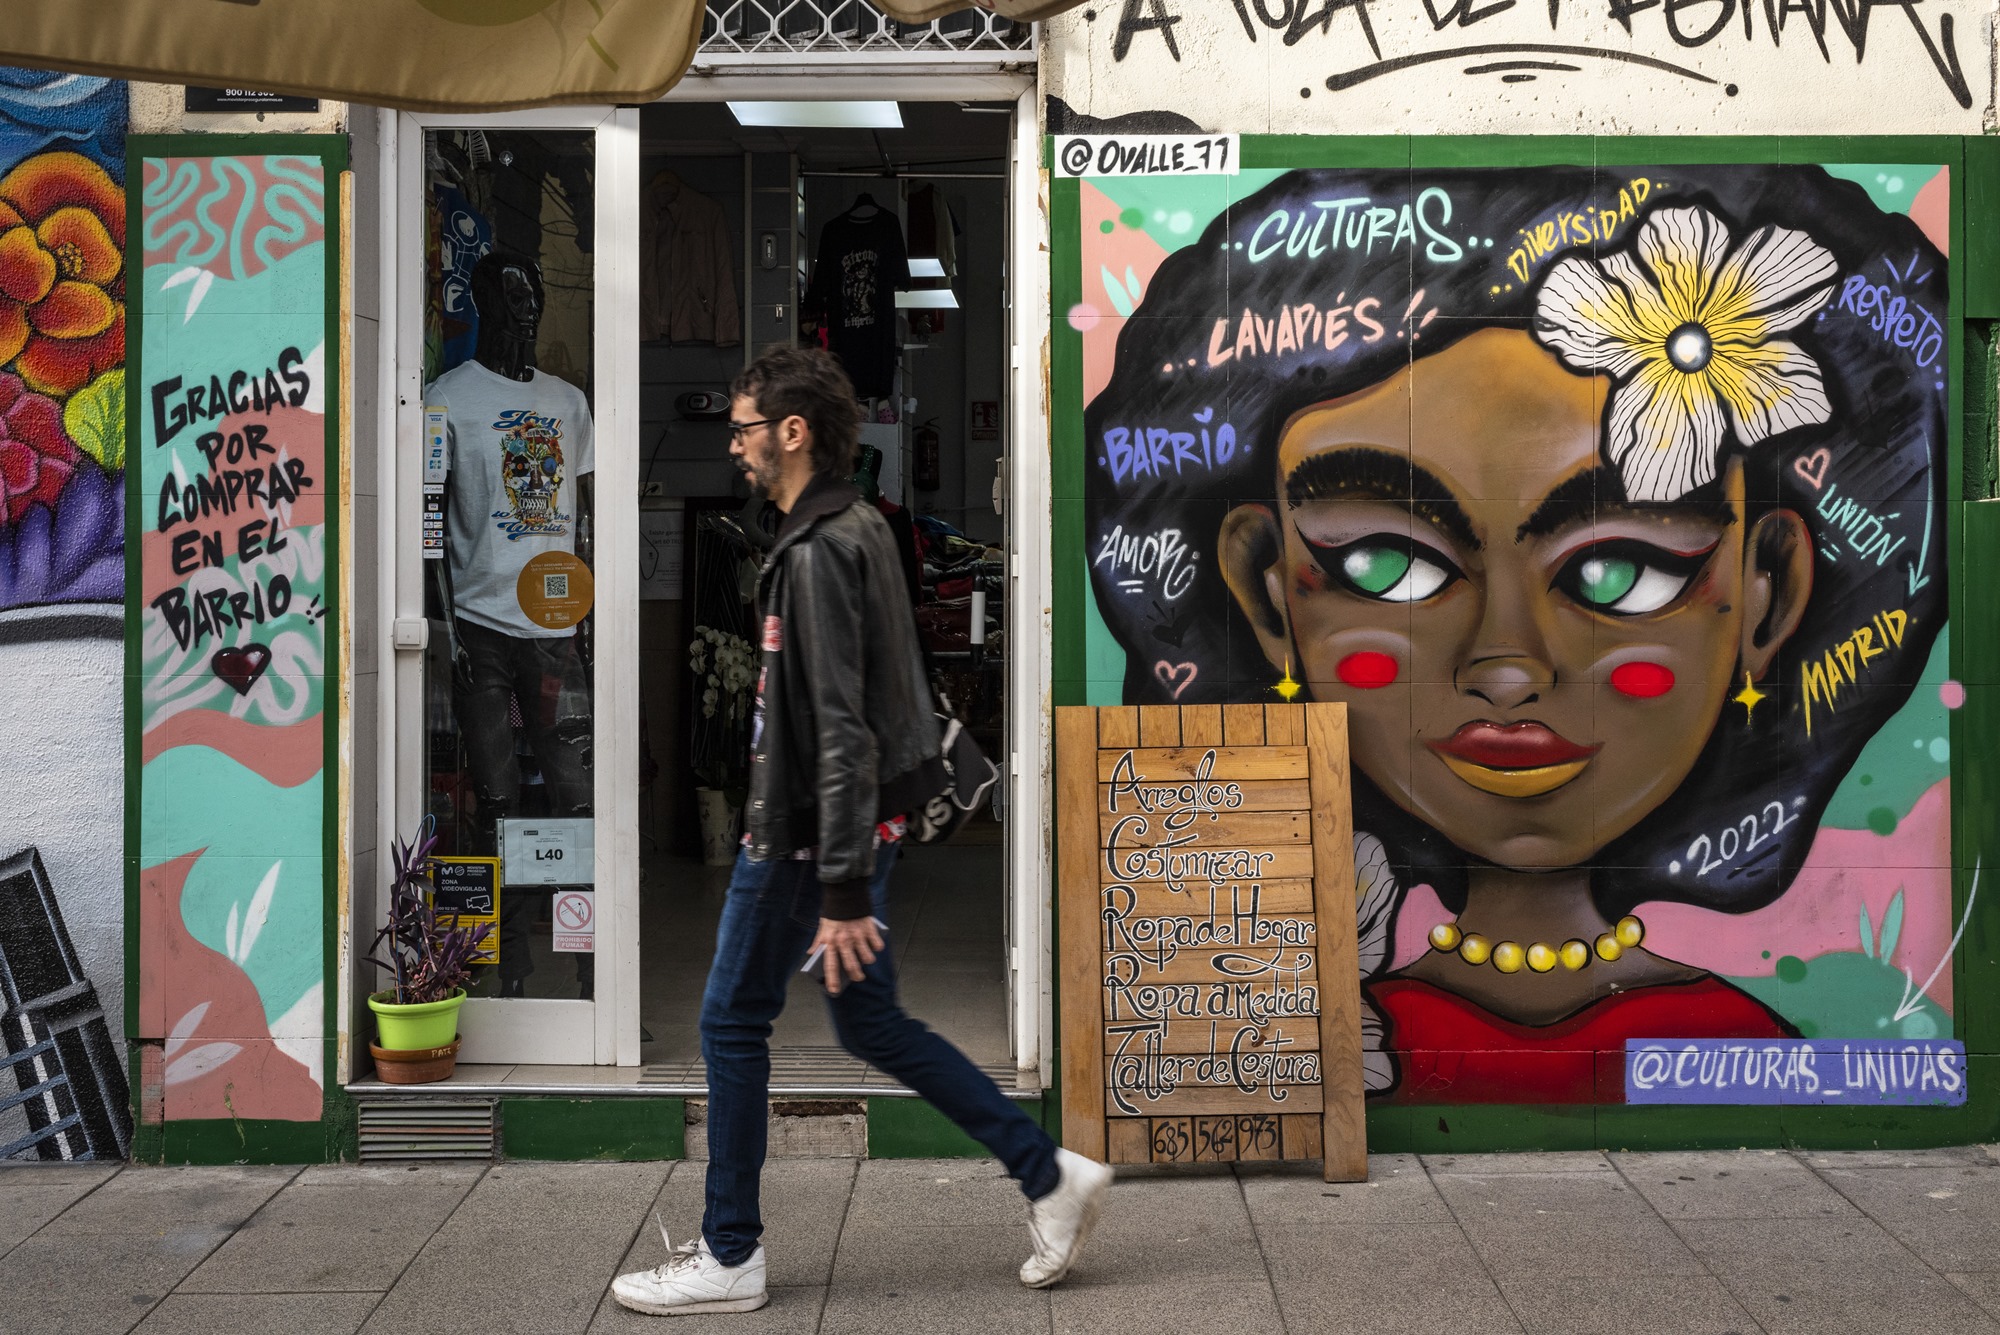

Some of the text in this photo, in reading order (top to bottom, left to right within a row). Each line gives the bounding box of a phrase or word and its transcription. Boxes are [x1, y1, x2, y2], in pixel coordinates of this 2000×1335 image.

[225, 88, 243, 96] 900
[151, 346, 310, 448] GRACIAS
[196, 424, 276, 472] POR
[157, 458, 313, 532] COMPRAR
[171, 517, 288, 575] EN EL
[1095, 525, 1196, 600] AMOR
[151, 574, 292, 651] BARRIO
[1801, 609, 1907, 738] MADRID
[1108, 749, 1243, 830] Arreglos
[535, 849, 563, 860] L40
[1106, 815, 1275, 892] Costumizar
[1686, 801, 1799, 876] 2022
[1154, 1116, 1277, 1161] 685 562 973
